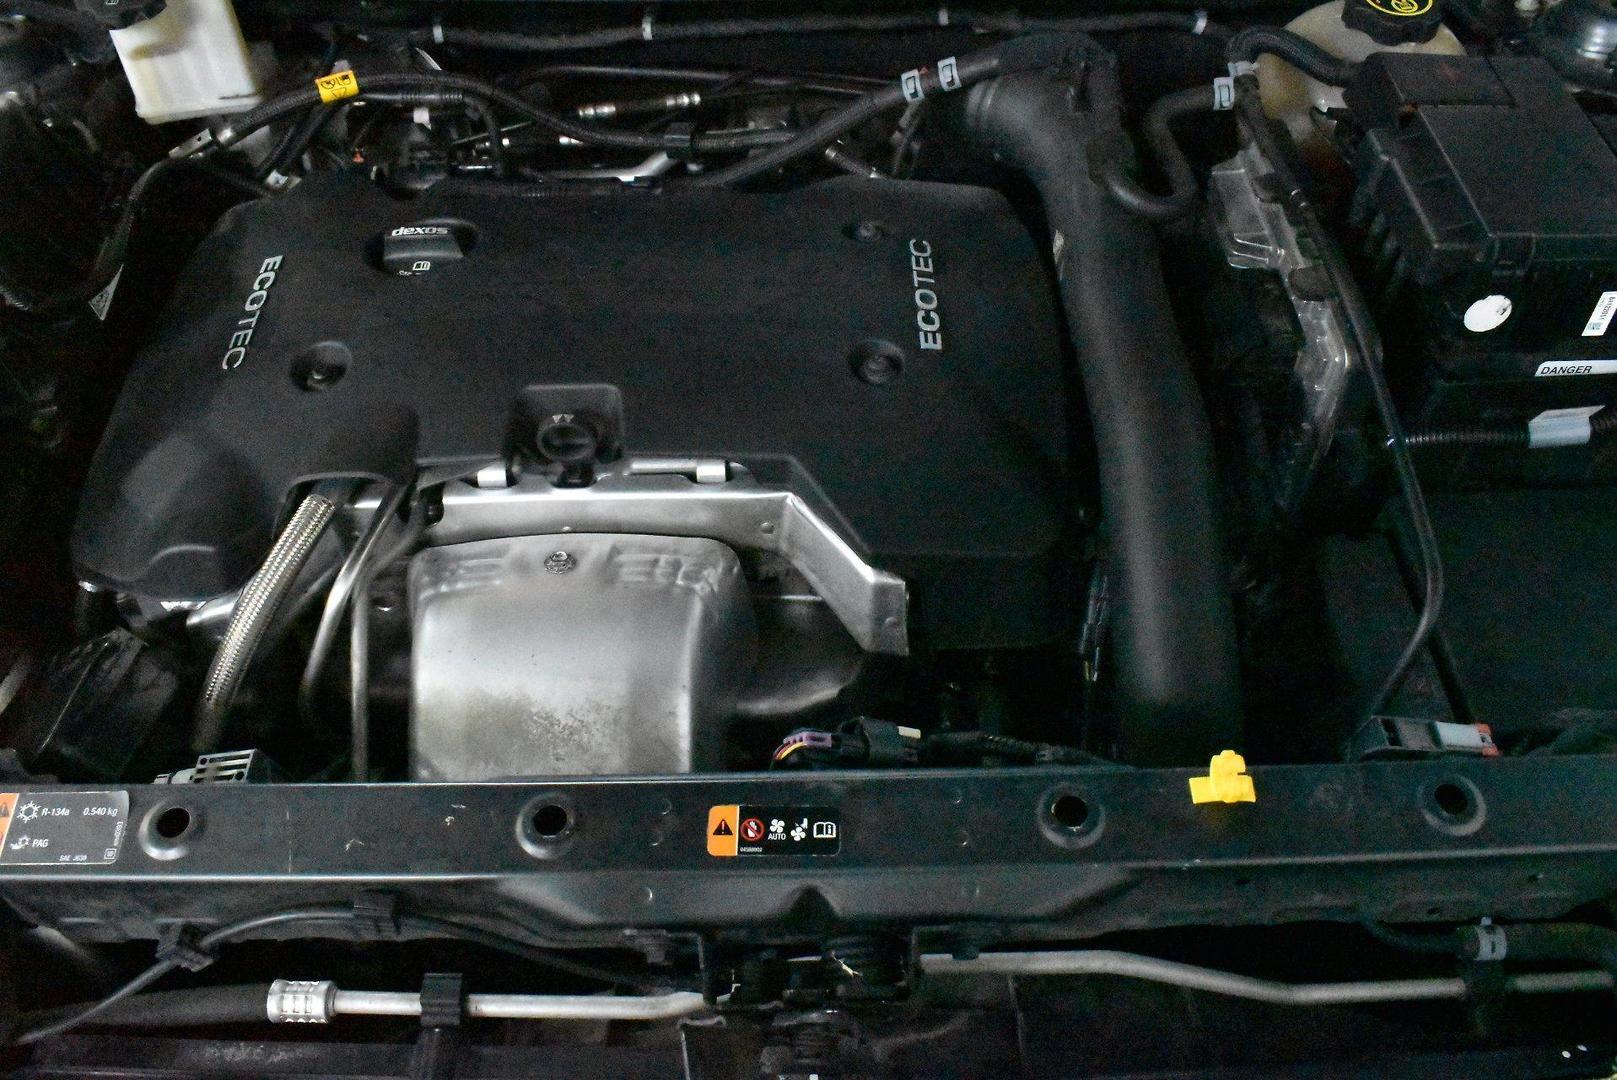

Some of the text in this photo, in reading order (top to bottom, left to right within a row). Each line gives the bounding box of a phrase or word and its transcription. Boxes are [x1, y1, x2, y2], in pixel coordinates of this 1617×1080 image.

[391, 226, 449, 237] dexos
[909, 239, 943, 350] ECOTEC
[222, 255, 284, 370] ECOTEC
[1540, 365, 1593, 375] DANGER
[41, 807, 70, 816] R-134a
[83, 807, 119, 817] 0.540 kg
[32, 839, 49, 848] PAG
